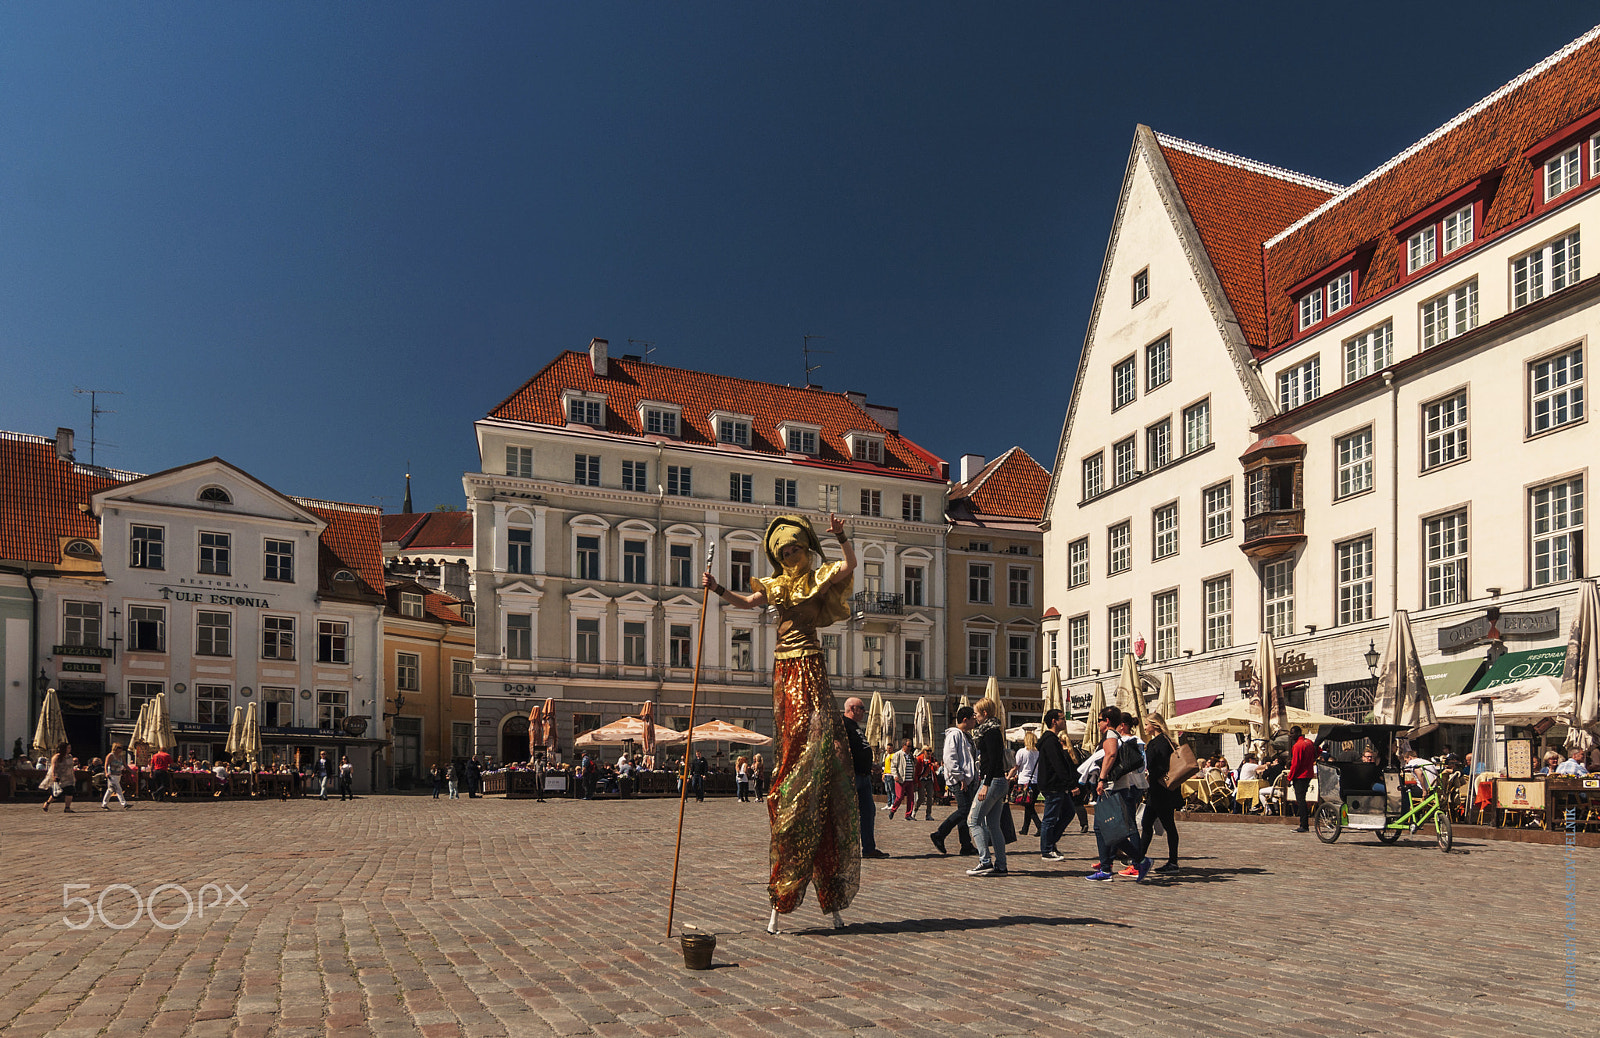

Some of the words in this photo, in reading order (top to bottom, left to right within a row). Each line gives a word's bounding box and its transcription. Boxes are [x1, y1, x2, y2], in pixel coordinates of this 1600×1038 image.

[180, 578, 249, 588] RESTORAN
[210, 594, 270, 608] ESTONIA
[56, 647, 109, 657] PIZZERIA
[1527, 651, 1566, 661] RESTORAN
[65, 663, 98, 672] GRILL
